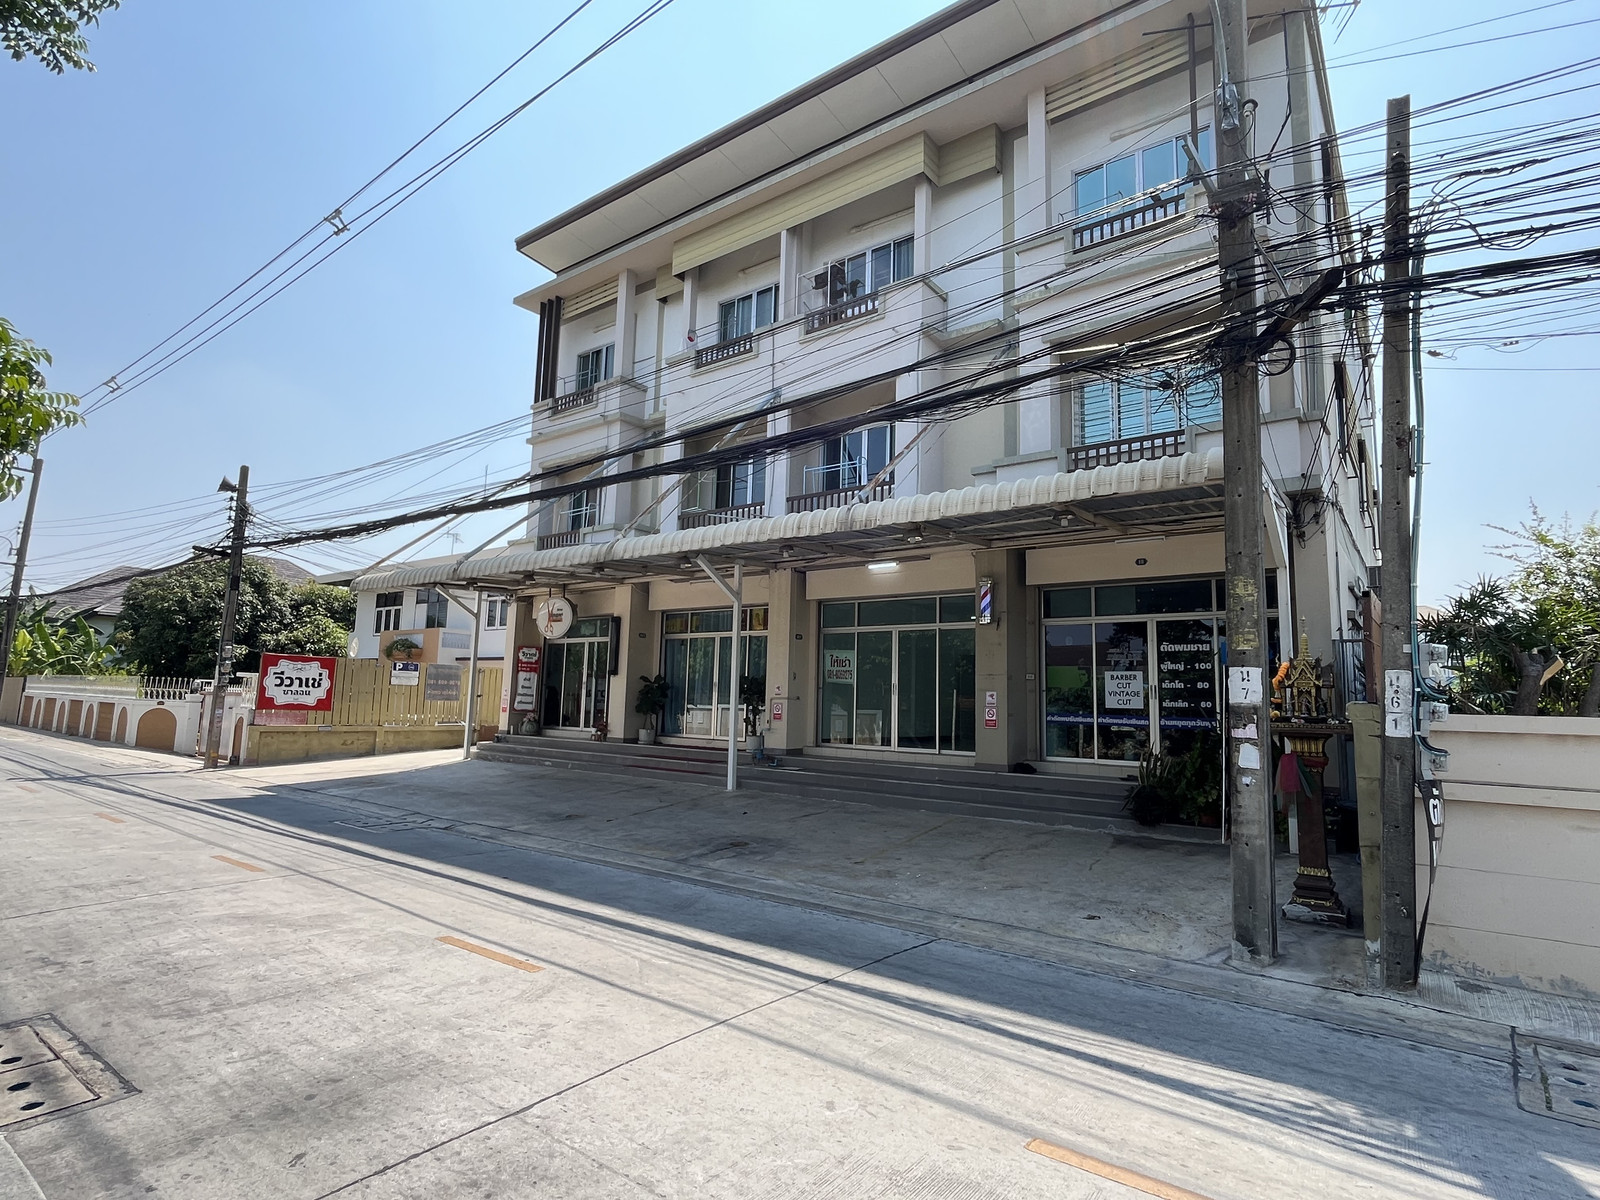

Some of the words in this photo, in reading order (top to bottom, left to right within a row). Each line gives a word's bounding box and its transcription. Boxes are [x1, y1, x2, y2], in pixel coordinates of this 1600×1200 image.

[1160, 642, 1210, 652] ตัดผมชาย
[829, 654, 851, 668] ให้เช่า
[396, 663, 403, 671] P
[1160, 661, 1185, 672] ผู้ใหญ่
[1194, 662, 1212, 670] 100
[273, 671, 324, 689] วีวาเช่
[1108, 690, 1141, 698] VINTAGE
[1241, 687, 1250, 700] 7
[1116, 698, 1132, 706] CUT
[1162, 699, 1189, 708] เด็กเล็ก
